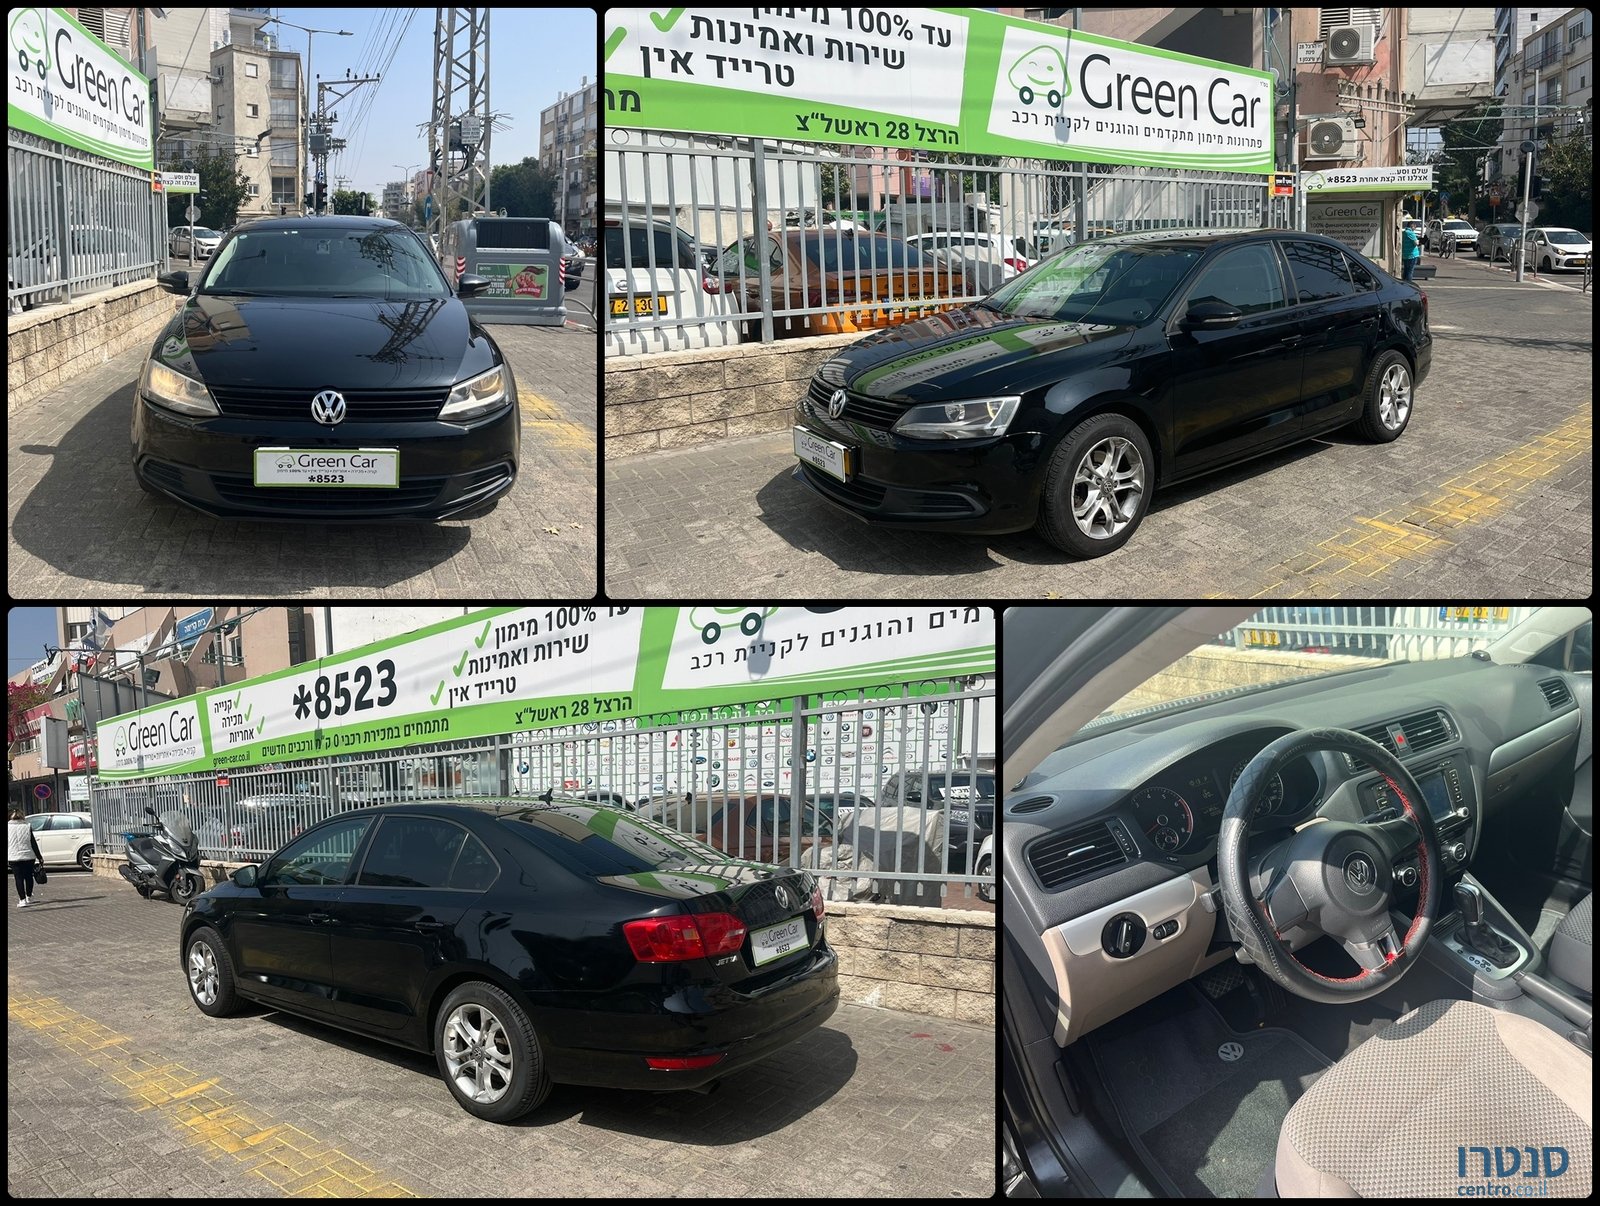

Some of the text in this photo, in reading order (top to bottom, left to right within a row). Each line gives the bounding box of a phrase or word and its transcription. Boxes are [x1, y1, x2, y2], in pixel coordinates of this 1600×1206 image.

[690, 14, 906, 70] שירות ואמינות
[922, 23, 951, 48] עד
[640, 45, 796, 88] טרייד אין
[15, 75, 34, 96] רכב
[55, 28, 146, 129] Green Car
[37, 86, 65, 111] לקניית
[1080, 53, 1262, 128] Green Car
[885, 121, 910, 141] 28
[914, 122, 960, 146] הרצל
[1011, 111, 1263, 149] פתרונות מימון מתקדמים והוגנים לקניית רכב
[1380, 175, 1396, 184] קצת
[1325, 205, 1378, 217] Green Car
[807, 437, 825, 454] Green
[826, 444, 836, 460] Car
[298, 454, 377, 469] Green Car
[544, 607, 597, 632] 100%
[494, 617, 539, 650] מימון
[820, 616, 914, 649] והוגנים
[468, 632, 590, 677] שירות ואמינות
[733, 632, 809, 664] לקניית
[690, 652, 725, 670] רכב
[448, 676, 517, 709] טרייד אין
[214, 698, 232, 714] קנייה
[571, 699, 590, 717] 28
[593, 696, 633, 714] הרצל
[128, 721, 167, 752] Green
[169, 710, 195, 743] Car
[221, 713, 243, 729] מכירה
[403, 717, 449, 738] מתמחים
[229, 728, 255, 744] אחריות
[333, 735, 340, 747] 0
[340, 733, 361, 746] רכבי
[363, 726, 401, 743] במכירת
[261, 743, 286, 757] חדשים
[288, 739, 313, 754] ורכבים
[212, 751, 251, 767] green-car.co.il
[768, 926, 787, 942] Green
[788, 923, 799, 935] Car
[715, 954, 738, 967] JETTA
